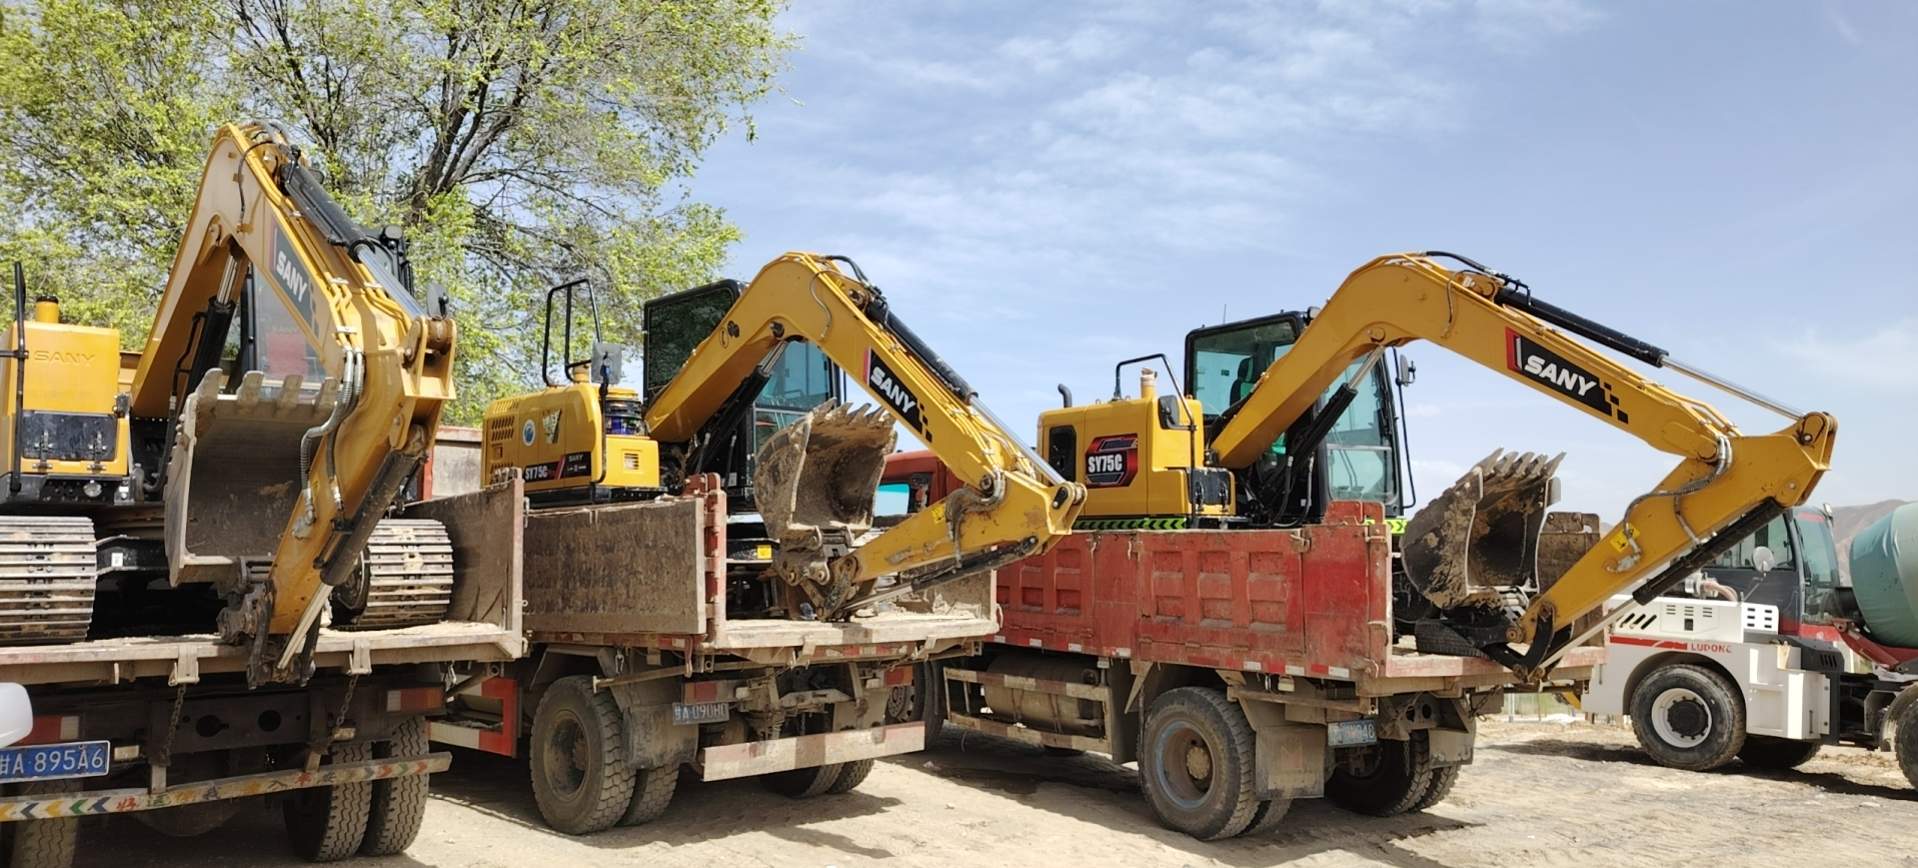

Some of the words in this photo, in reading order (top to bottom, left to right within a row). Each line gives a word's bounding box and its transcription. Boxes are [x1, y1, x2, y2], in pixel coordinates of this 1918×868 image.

[277, 250, 307, 302] SANY
[34, 350, 96, 368] SANY
[1524, 354, 1597, 396] SANY
[871, 366, 916, 413] SANY
[1088, 454, 1122, 473] SY75C
